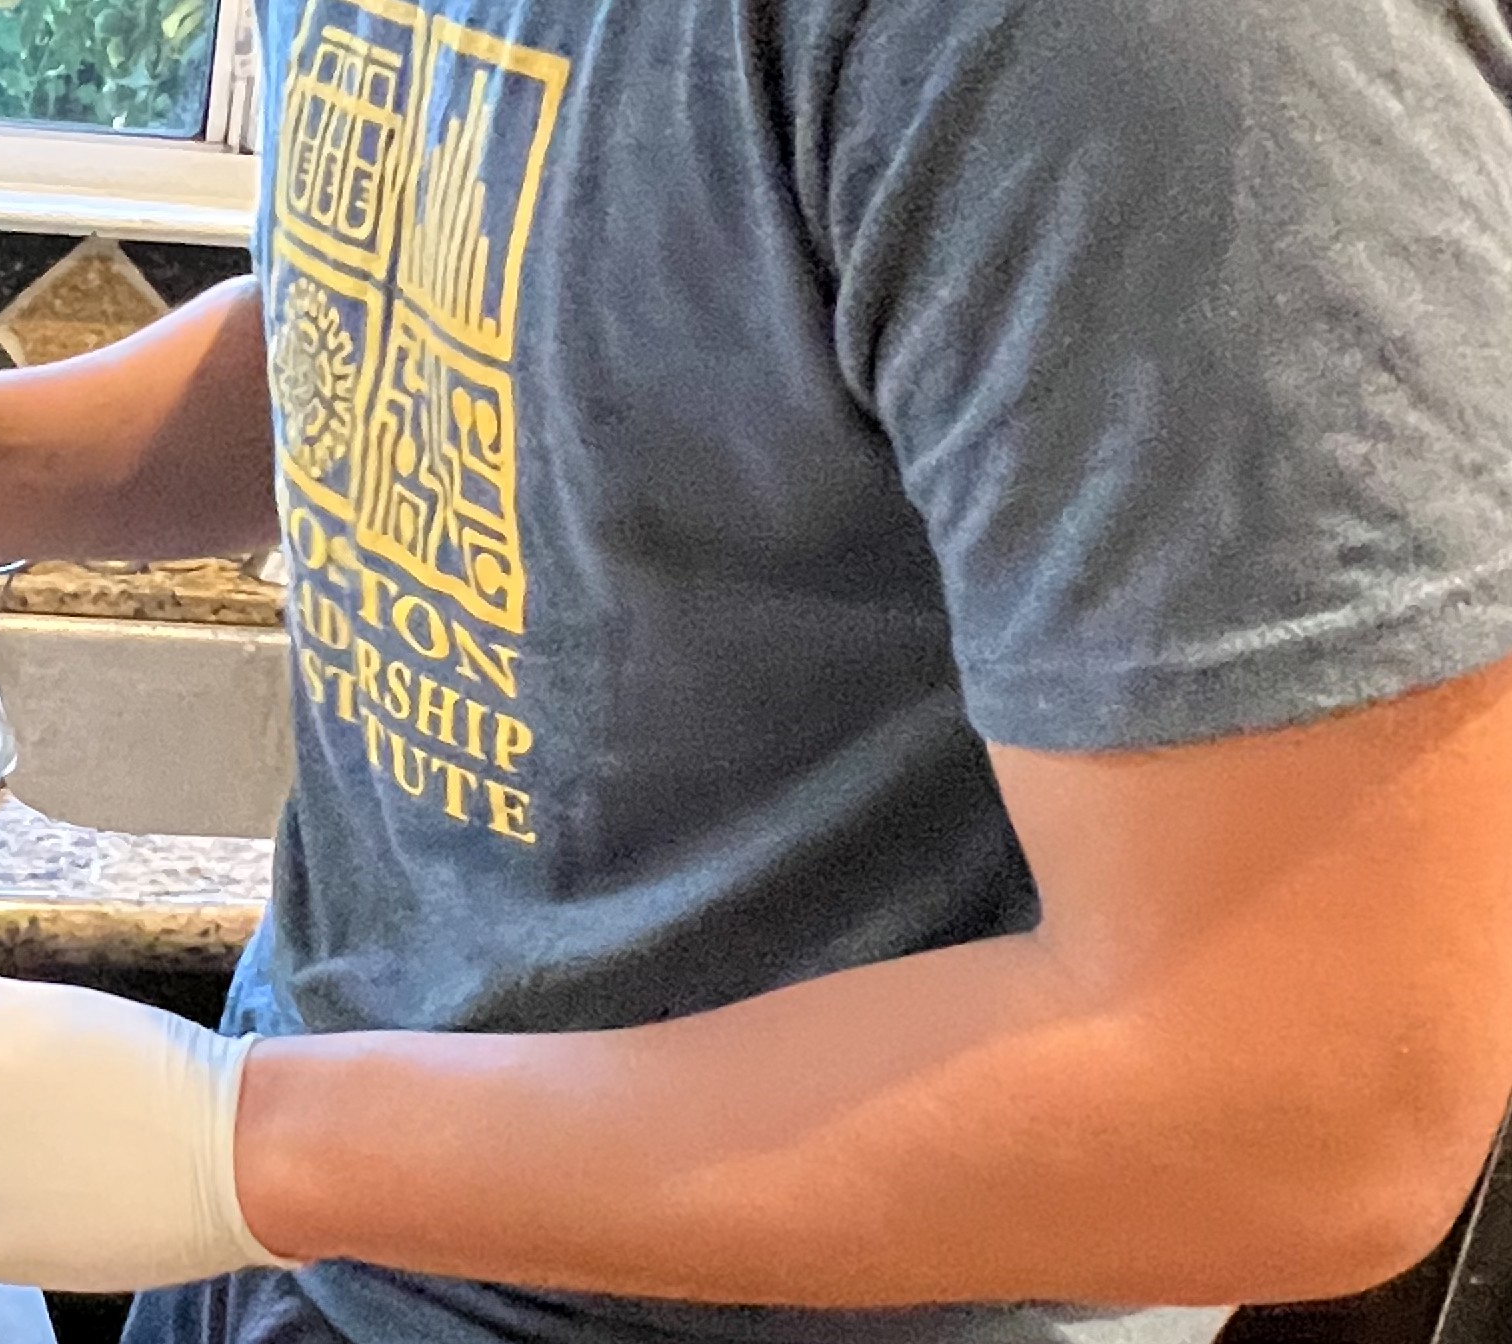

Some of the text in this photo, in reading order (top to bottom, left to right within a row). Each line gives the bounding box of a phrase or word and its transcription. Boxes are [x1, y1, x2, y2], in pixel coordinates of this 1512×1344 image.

[289, 507, 520, 699] OSTON
[297, 580, 534, 773] ADRSHIP
[299, 648, 536, 844] STTUTE
